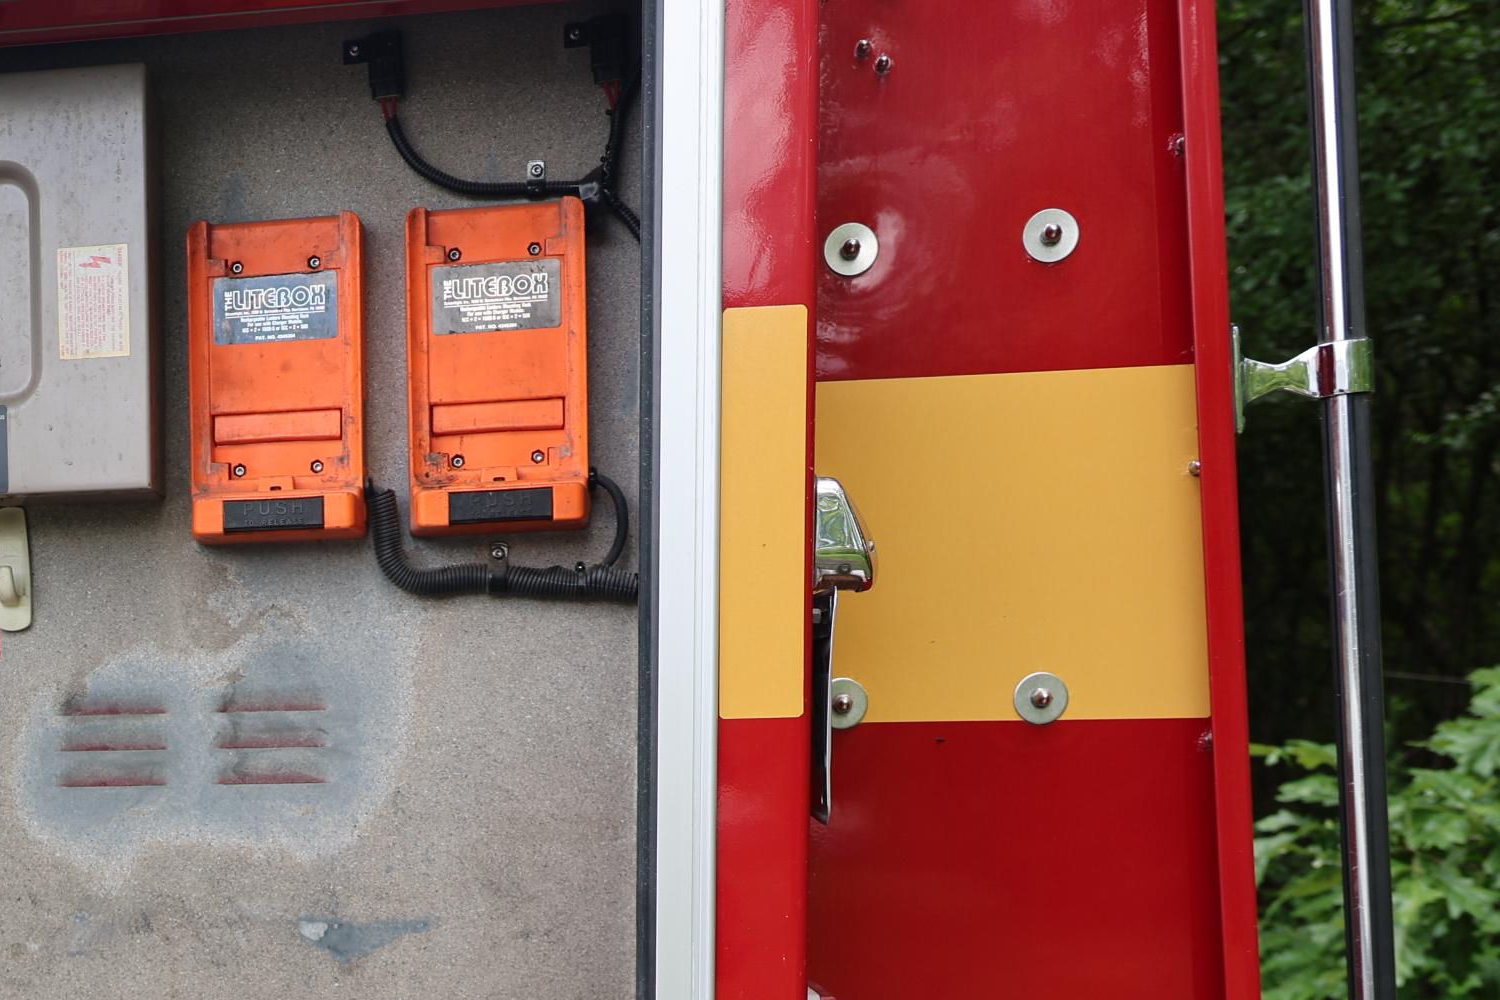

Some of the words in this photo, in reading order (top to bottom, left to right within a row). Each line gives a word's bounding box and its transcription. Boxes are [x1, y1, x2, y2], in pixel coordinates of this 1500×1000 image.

[224, 291, 232, 311] THE
[233, 284, 325, 310] LITEBOX
[444, 280, 452, 300] THE
[452, 273, 548, 299] LITEBOX
[243, 500, 303, 515] PUSH
